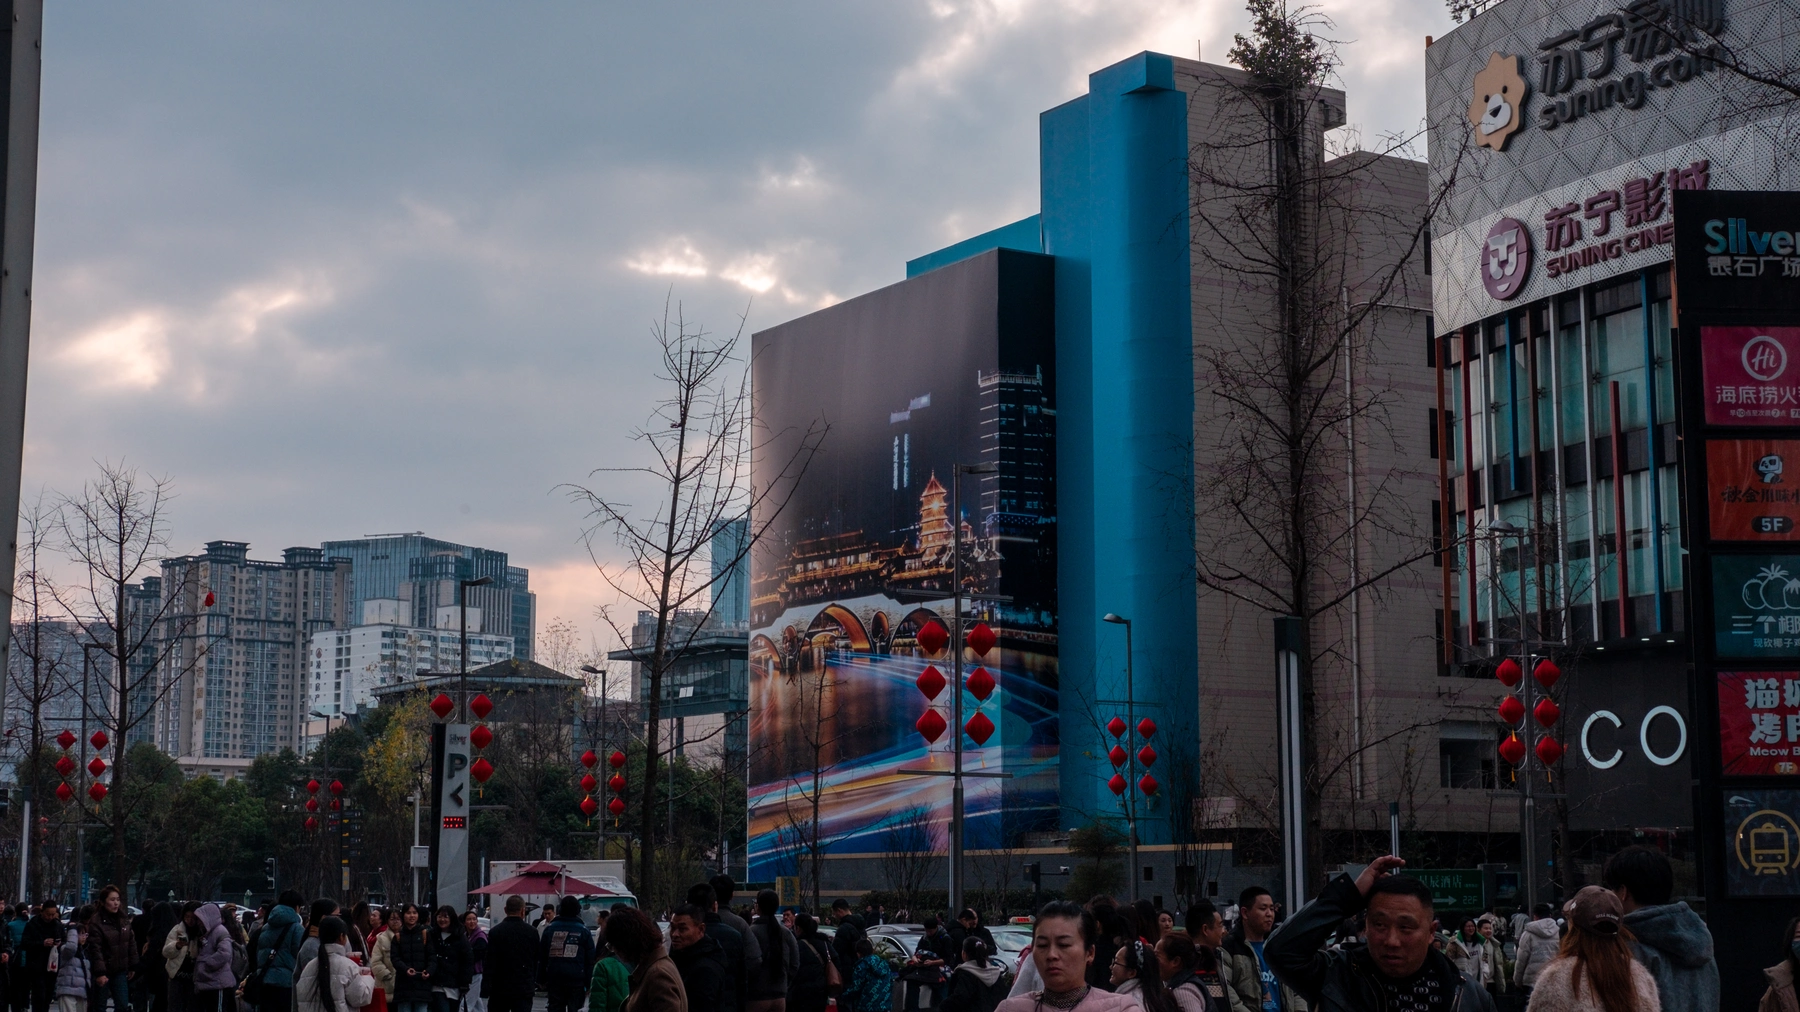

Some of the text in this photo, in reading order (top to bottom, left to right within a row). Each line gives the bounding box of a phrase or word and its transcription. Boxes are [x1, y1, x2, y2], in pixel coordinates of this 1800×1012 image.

[1539, 43, 1727, 131] suning.com
[1546, 238, 1622, 278] SUNING
[1751, 345, 1778, 371] Hi
[1715, 385, 1800, 405] 海底捞火
[1761, 518, 1784, 532] 5F
[1749, 712, 1800, 745] 烤
[1749, 746, 1789, 757] Meow
[447, 753, 468, 779] P
[1778, 762, 1794, 773] 7F
[1462, 895, 1478, 905] 22F
